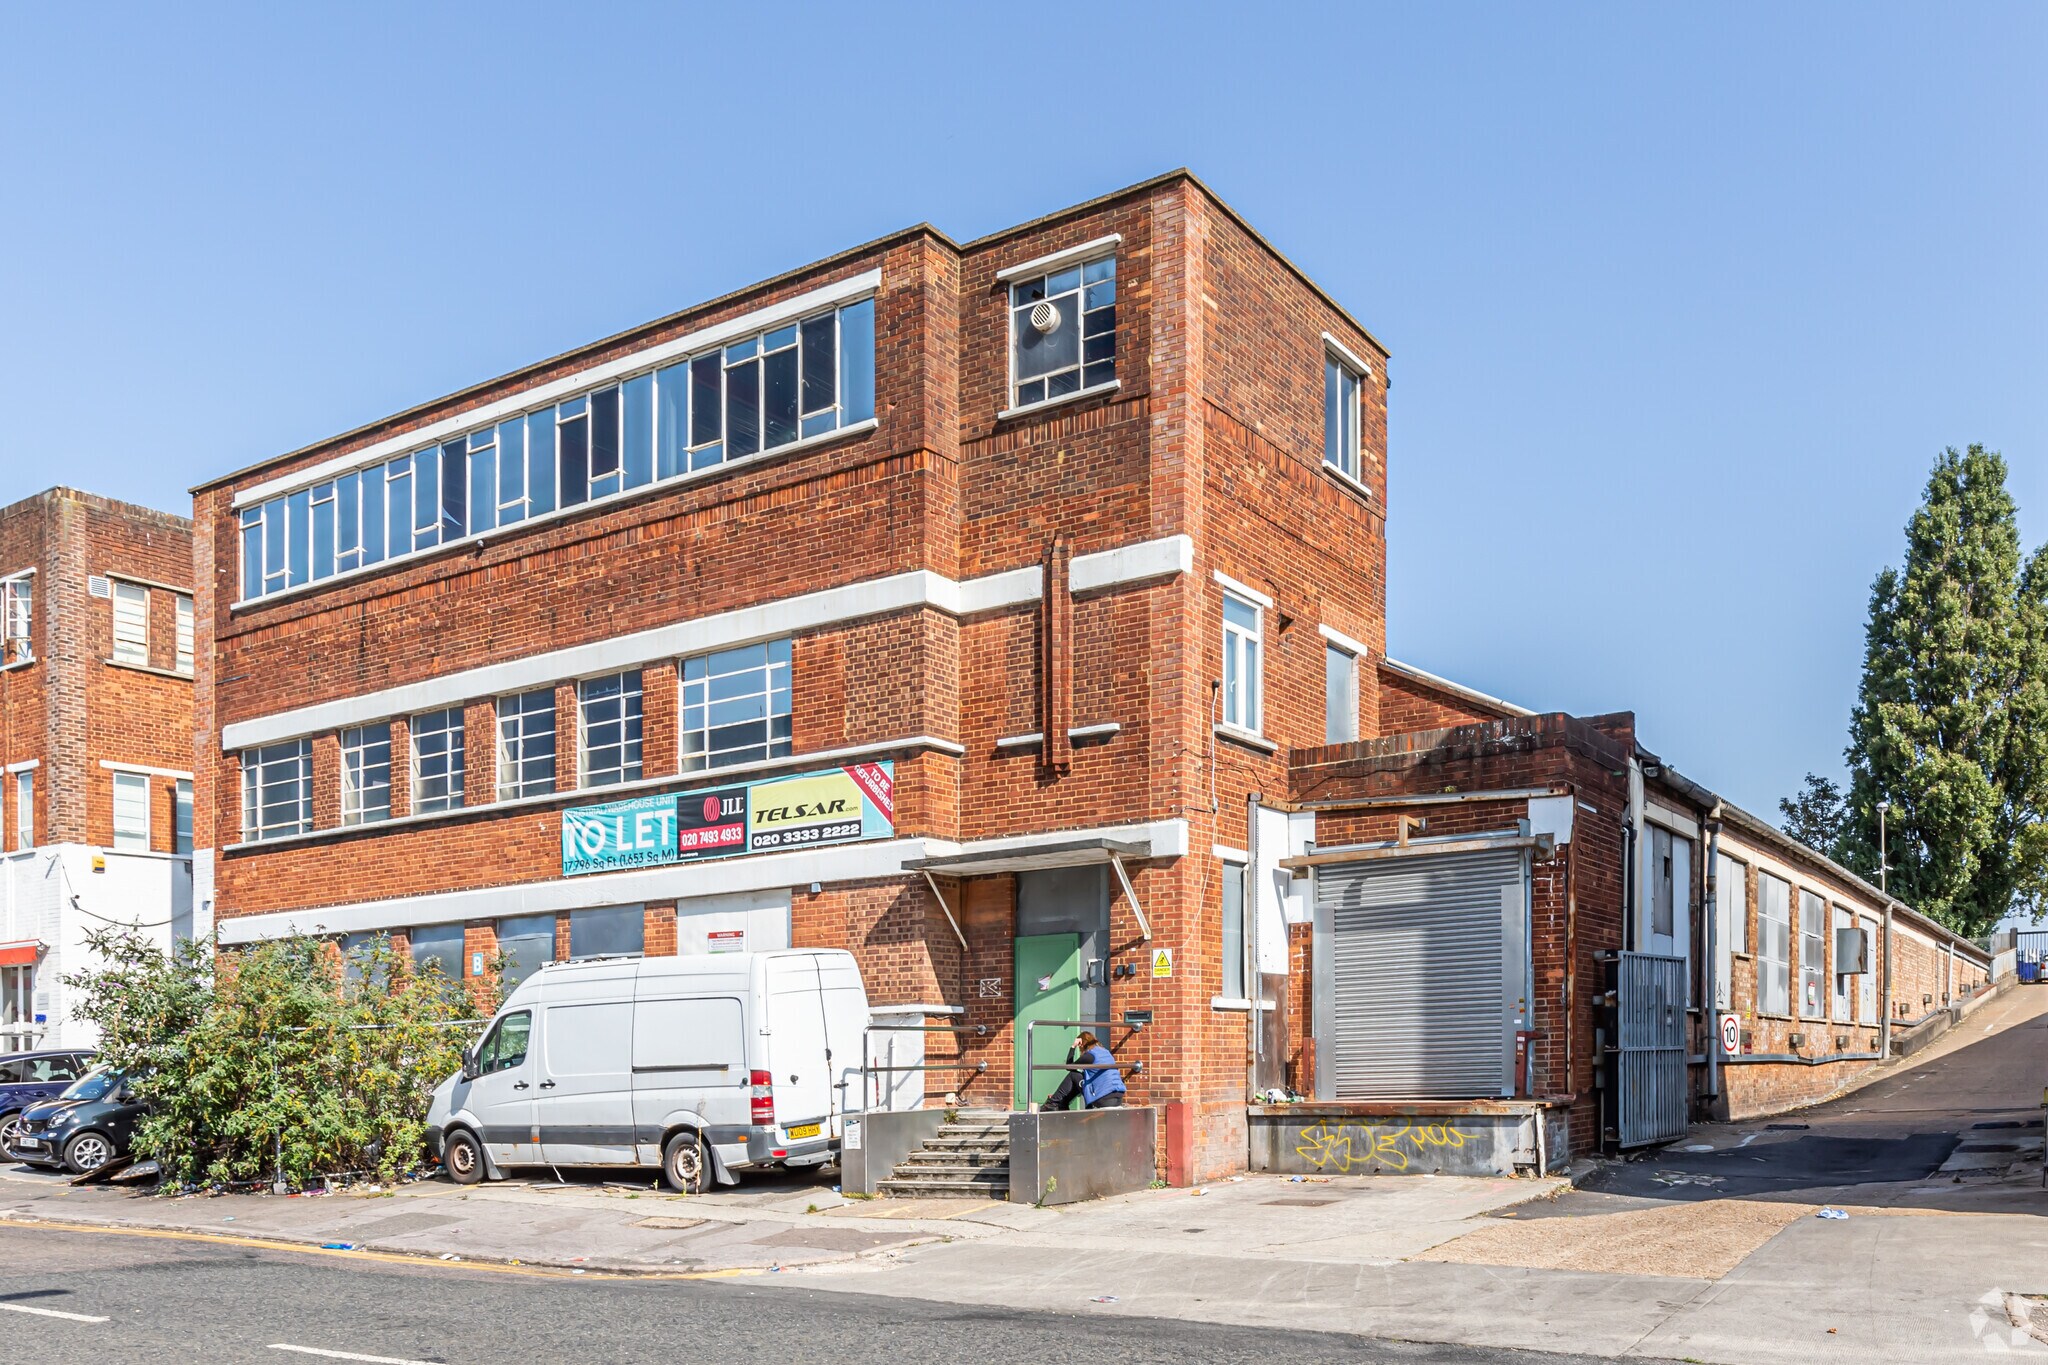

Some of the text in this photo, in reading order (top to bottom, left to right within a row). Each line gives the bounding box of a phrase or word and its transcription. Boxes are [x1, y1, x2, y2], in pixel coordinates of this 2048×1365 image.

[854, 764, 893, 811] REFURBISHED
[871, 767, 890, 792] TO BE
[656, 795, 674, 806] UNIT
[720, 797, 744, 816] JLL
[562, 809, 675, 858] TO LET
[682, 827, 741, 847] 020 7493 4933
[753, 823, 860, 847] 020 3333 2222
[593, 858, 605, 869] Sq
[607, 856, 617, 867] Ft
[647, 851, 659, 862] Sq
[661, 848, 675, 860] M)
[473, 956, 481, 972] B
[1724, 1026, 1736, 1043] 10
